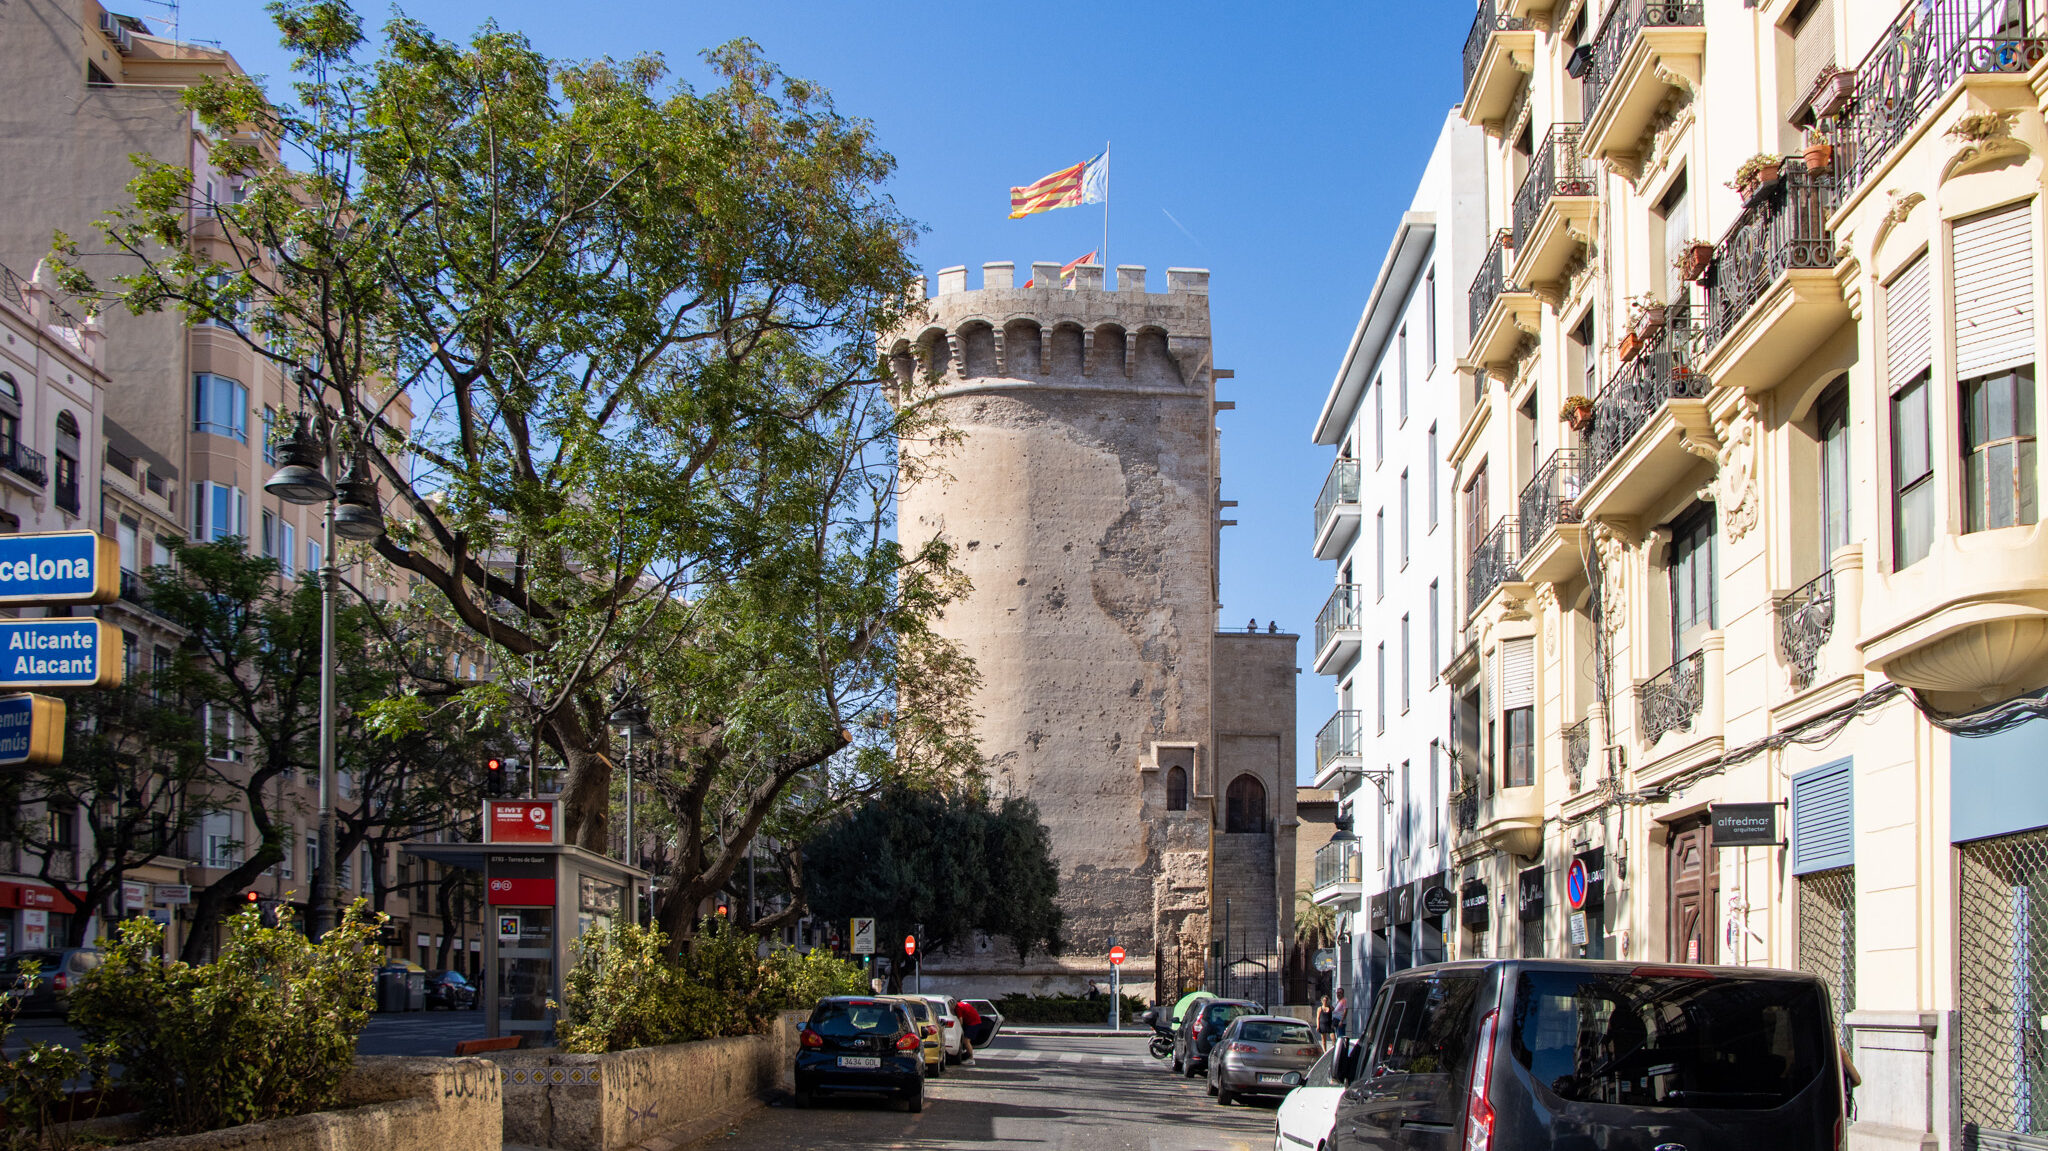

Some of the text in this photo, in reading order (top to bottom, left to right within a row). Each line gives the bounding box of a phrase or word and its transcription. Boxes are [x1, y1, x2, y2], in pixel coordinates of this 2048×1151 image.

[9, 631, 93, 650] Alicante
[14, 655, 93, 674] Alacant
[844, 1057, 861, 1065] 3434
